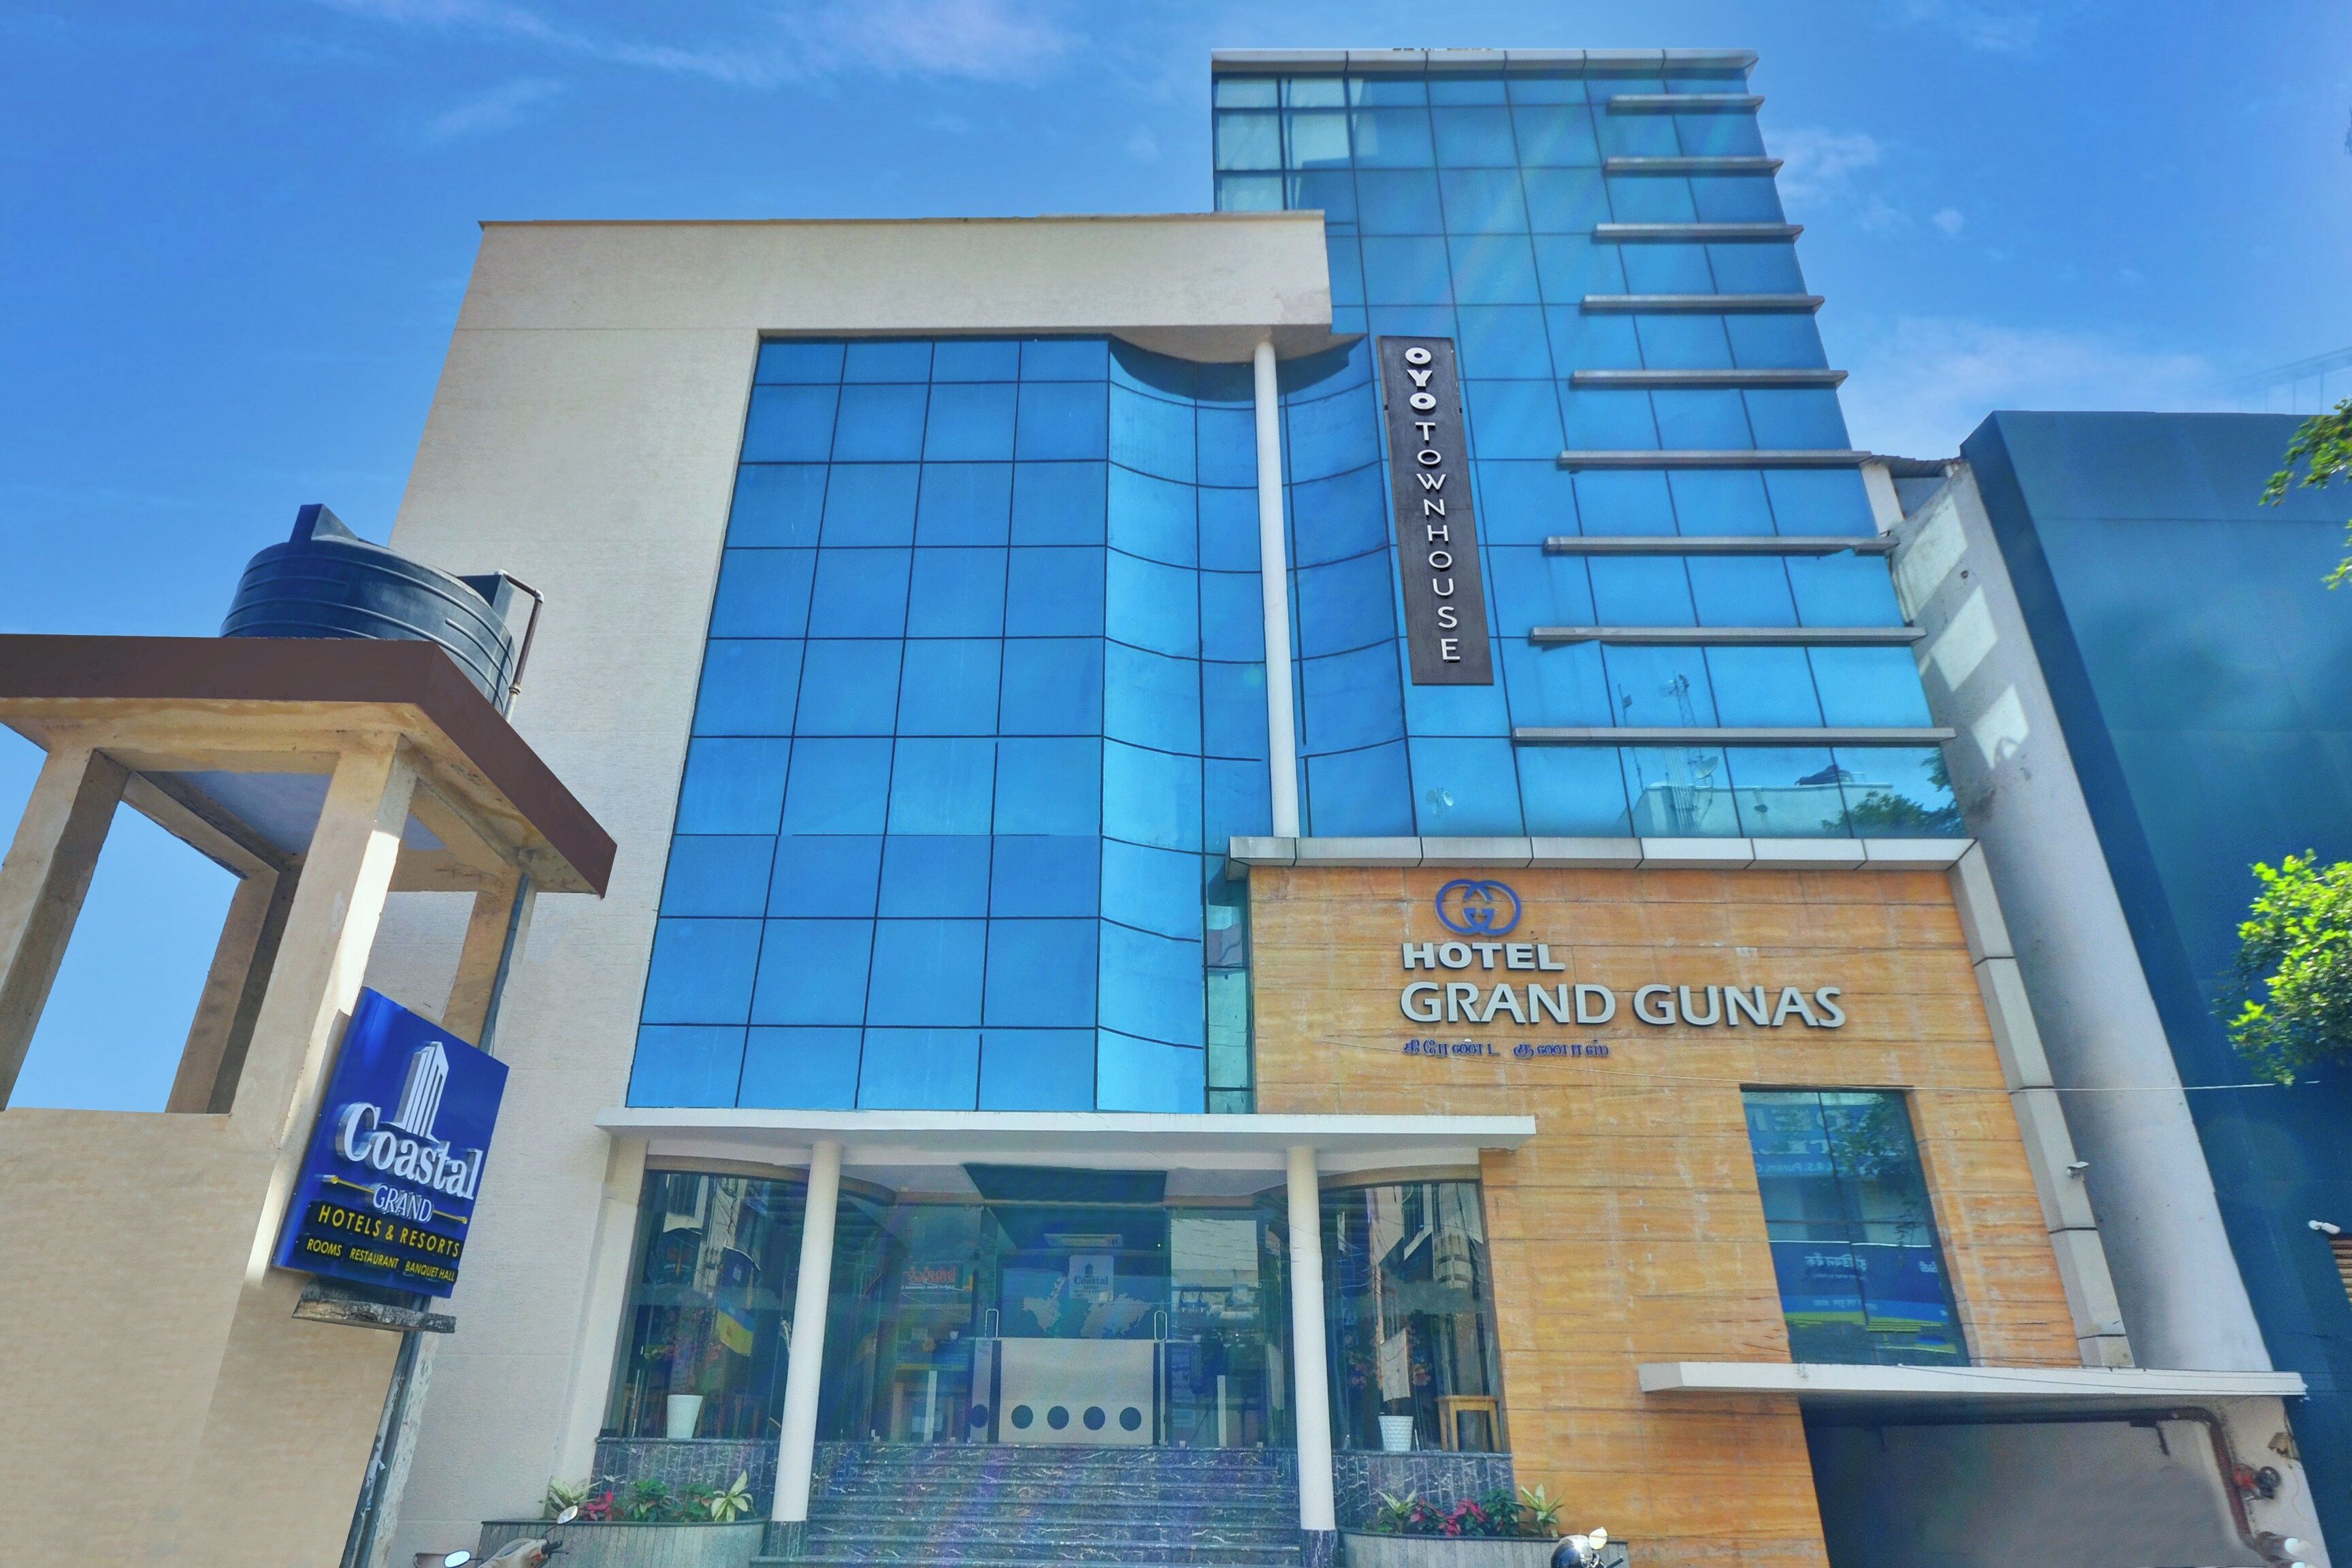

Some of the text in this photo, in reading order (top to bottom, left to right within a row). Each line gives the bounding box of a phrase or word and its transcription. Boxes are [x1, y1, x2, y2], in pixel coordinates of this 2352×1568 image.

[1405, 347, 1460, 662] OYO TOWNHOUSE
[1403, 943, 1565, 971] HOTEL
[1400, 981, 1846, 1028] GRAND GUNAS
[338, 1102, 483, 1200] Coastal
[373, 1183, 434, 1223] GRAND
[318, 1205, 460, 1258] HOTELS & RESORTS
[306, 1238, 455, 1282] ROOMS RESTAURANT BANQUET HALL
[1075, 1275, 1108, 1285] Coastal
